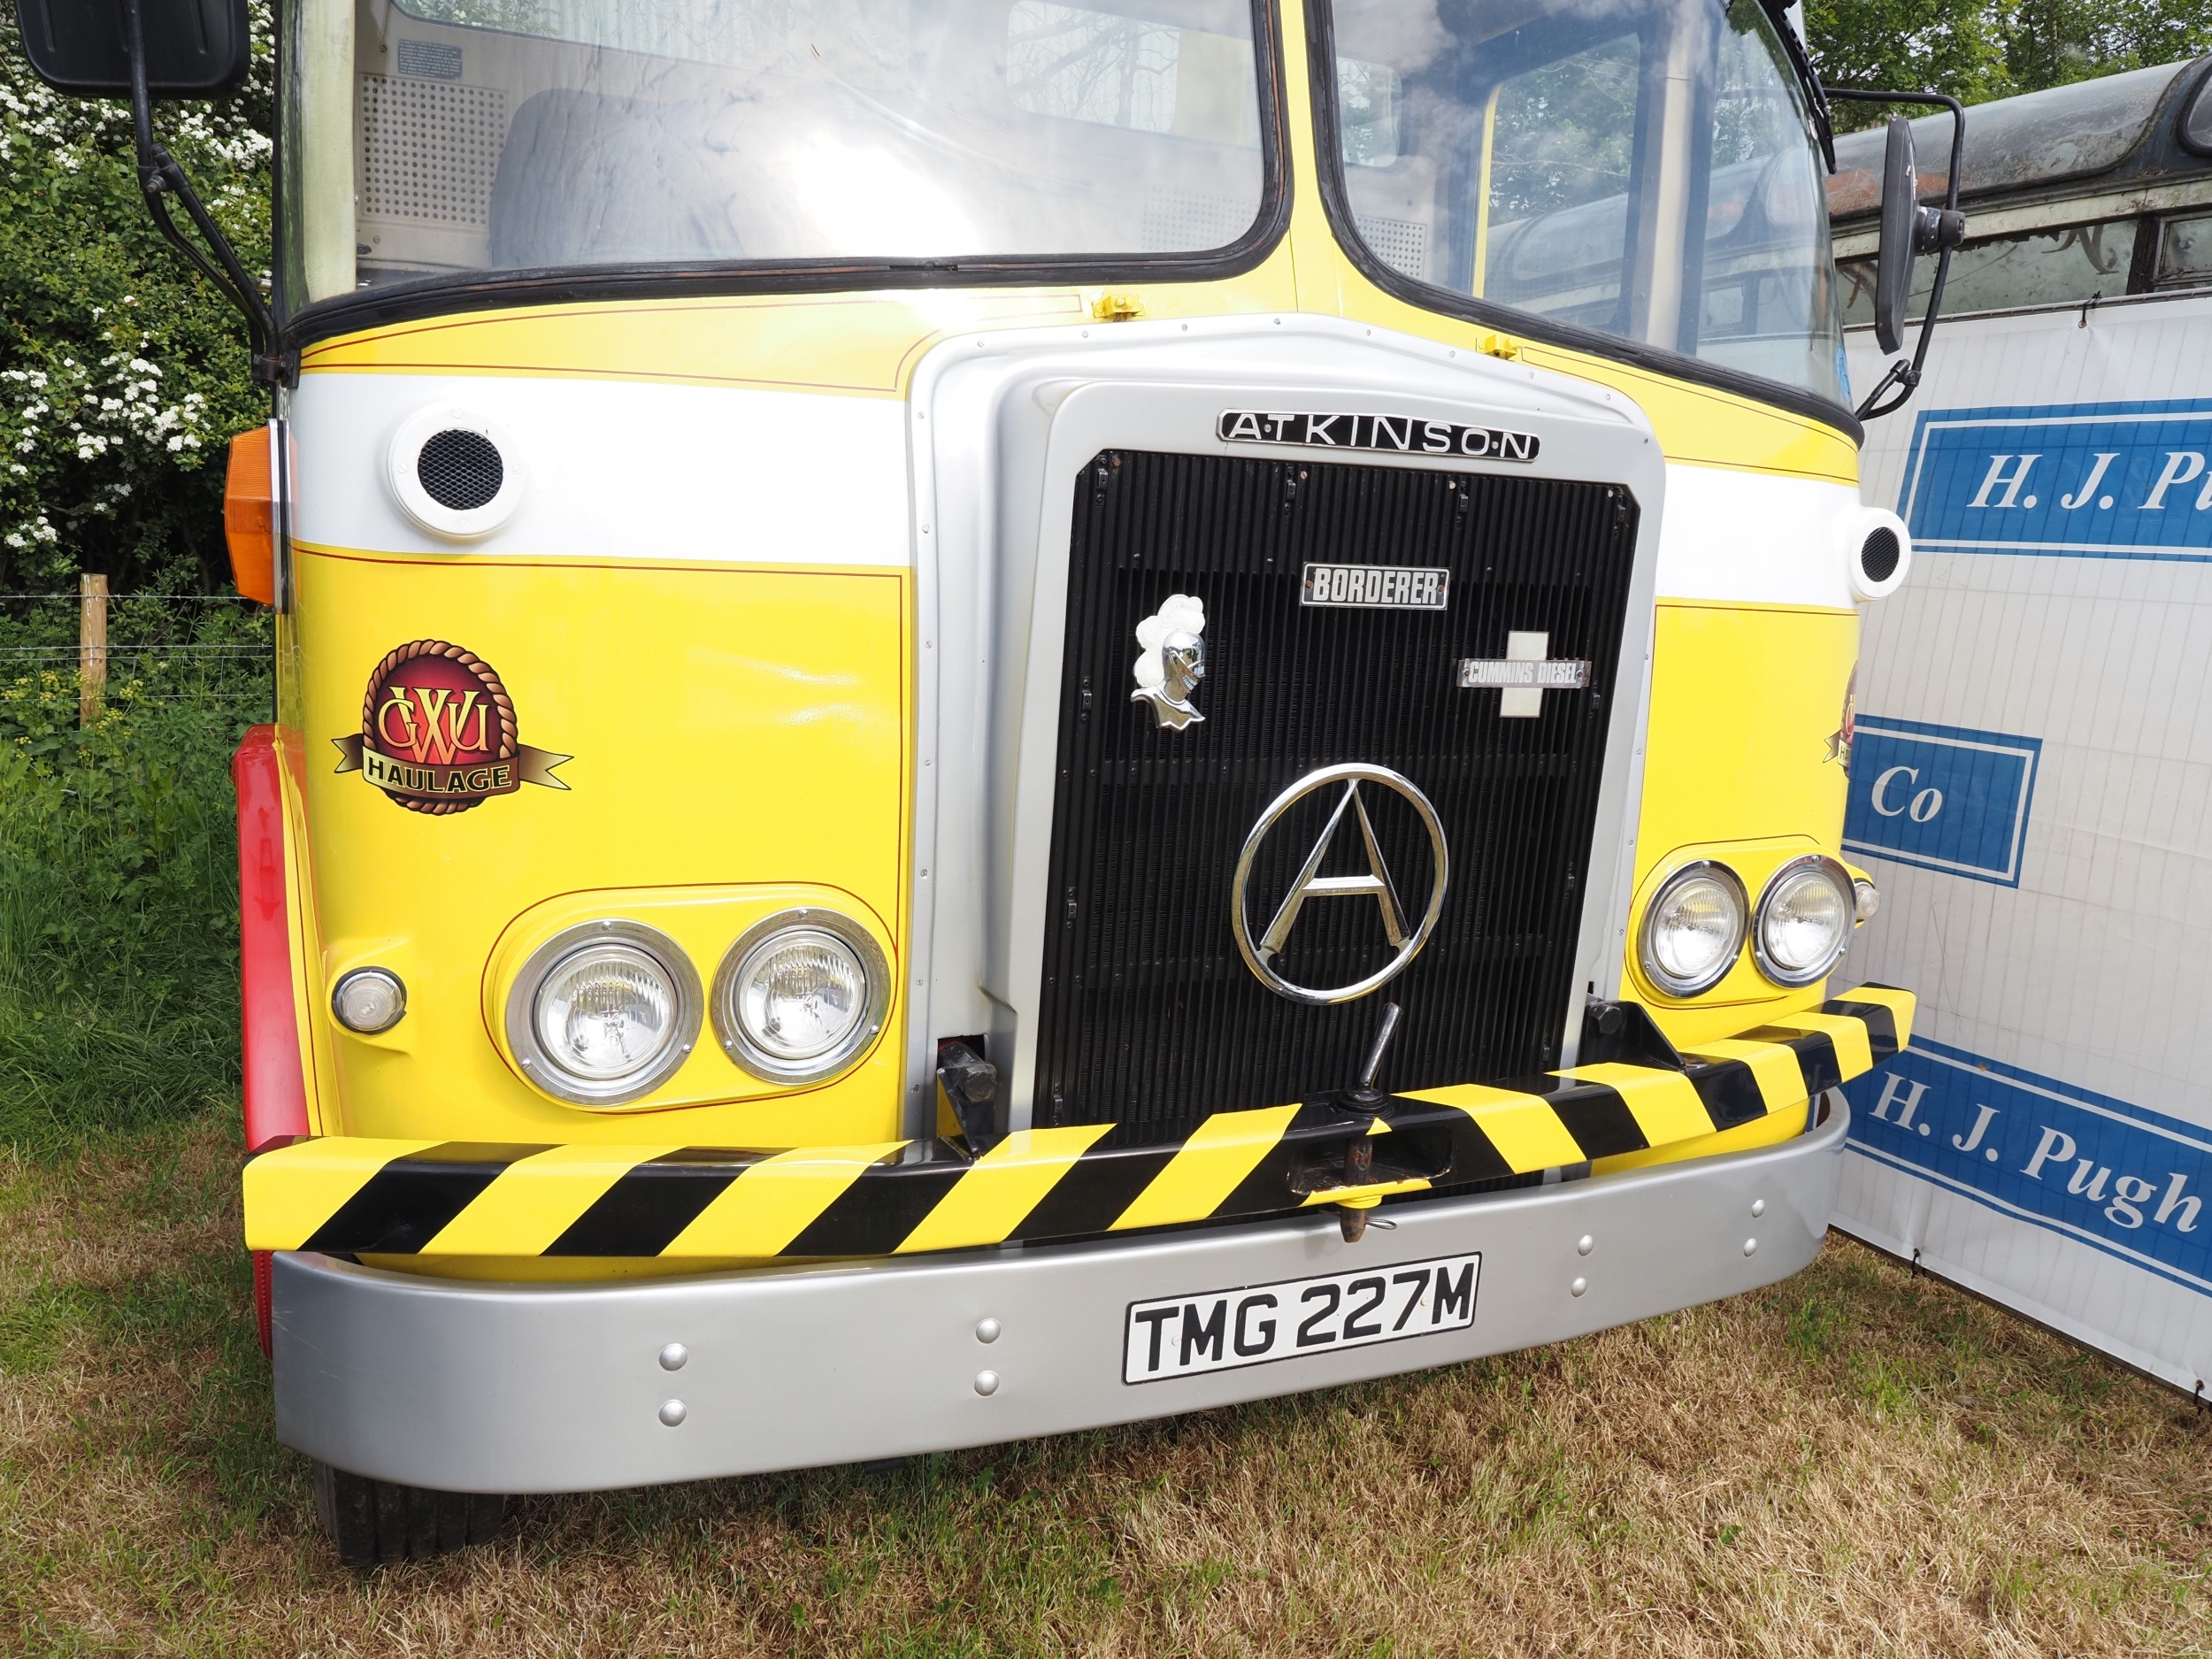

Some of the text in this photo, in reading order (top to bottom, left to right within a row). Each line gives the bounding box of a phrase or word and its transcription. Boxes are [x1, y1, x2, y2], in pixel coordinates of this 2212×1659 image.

[1228, 412, 1532, 460] ATKINSON
[1966, 453, 2043, 510] H.
[2060, 452, 2121, 510] J.
[1312, 567, 1440, 605] BORDERER
[1468, 661, 1577, 684] CUMMINS DIESEL
[367, 755, 512, 795] HAULAGE
[1870, 765, 1943, 823] Co
[1256, 777, 1413, 956] A
[1869, 1071, 2203, 1233] H. J. Pugh
[1134, 1262, 1475, 1372] TMG 227M
